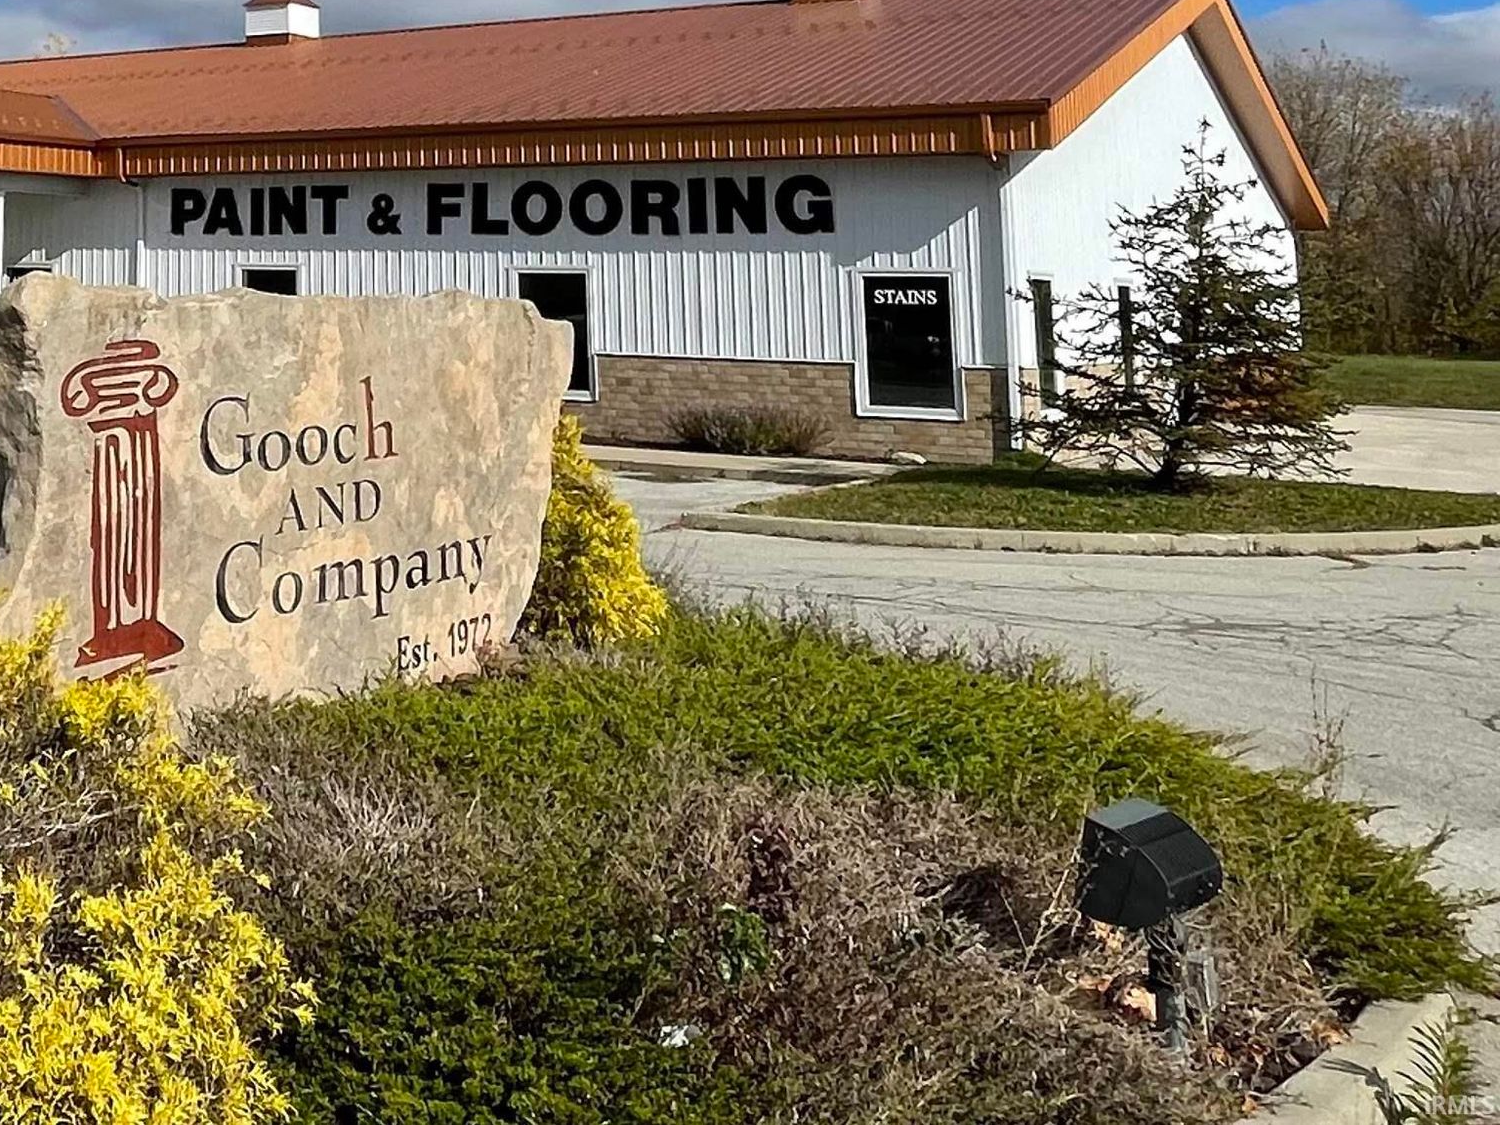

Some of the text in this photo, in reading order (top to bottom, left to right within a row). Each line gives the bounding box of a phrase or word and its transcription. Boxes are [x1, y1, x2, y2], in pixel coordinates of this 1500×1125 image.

[171, 175, 836, 236] PAINT & FLOORING
[873, 288, 938, 305] STAINS
[200, 375, 398, 476] Gooch
[275, 479, 382, 535] AND
[216, 534, 492, 623] Company
[397, 613, 493, 672] Est. 1972
